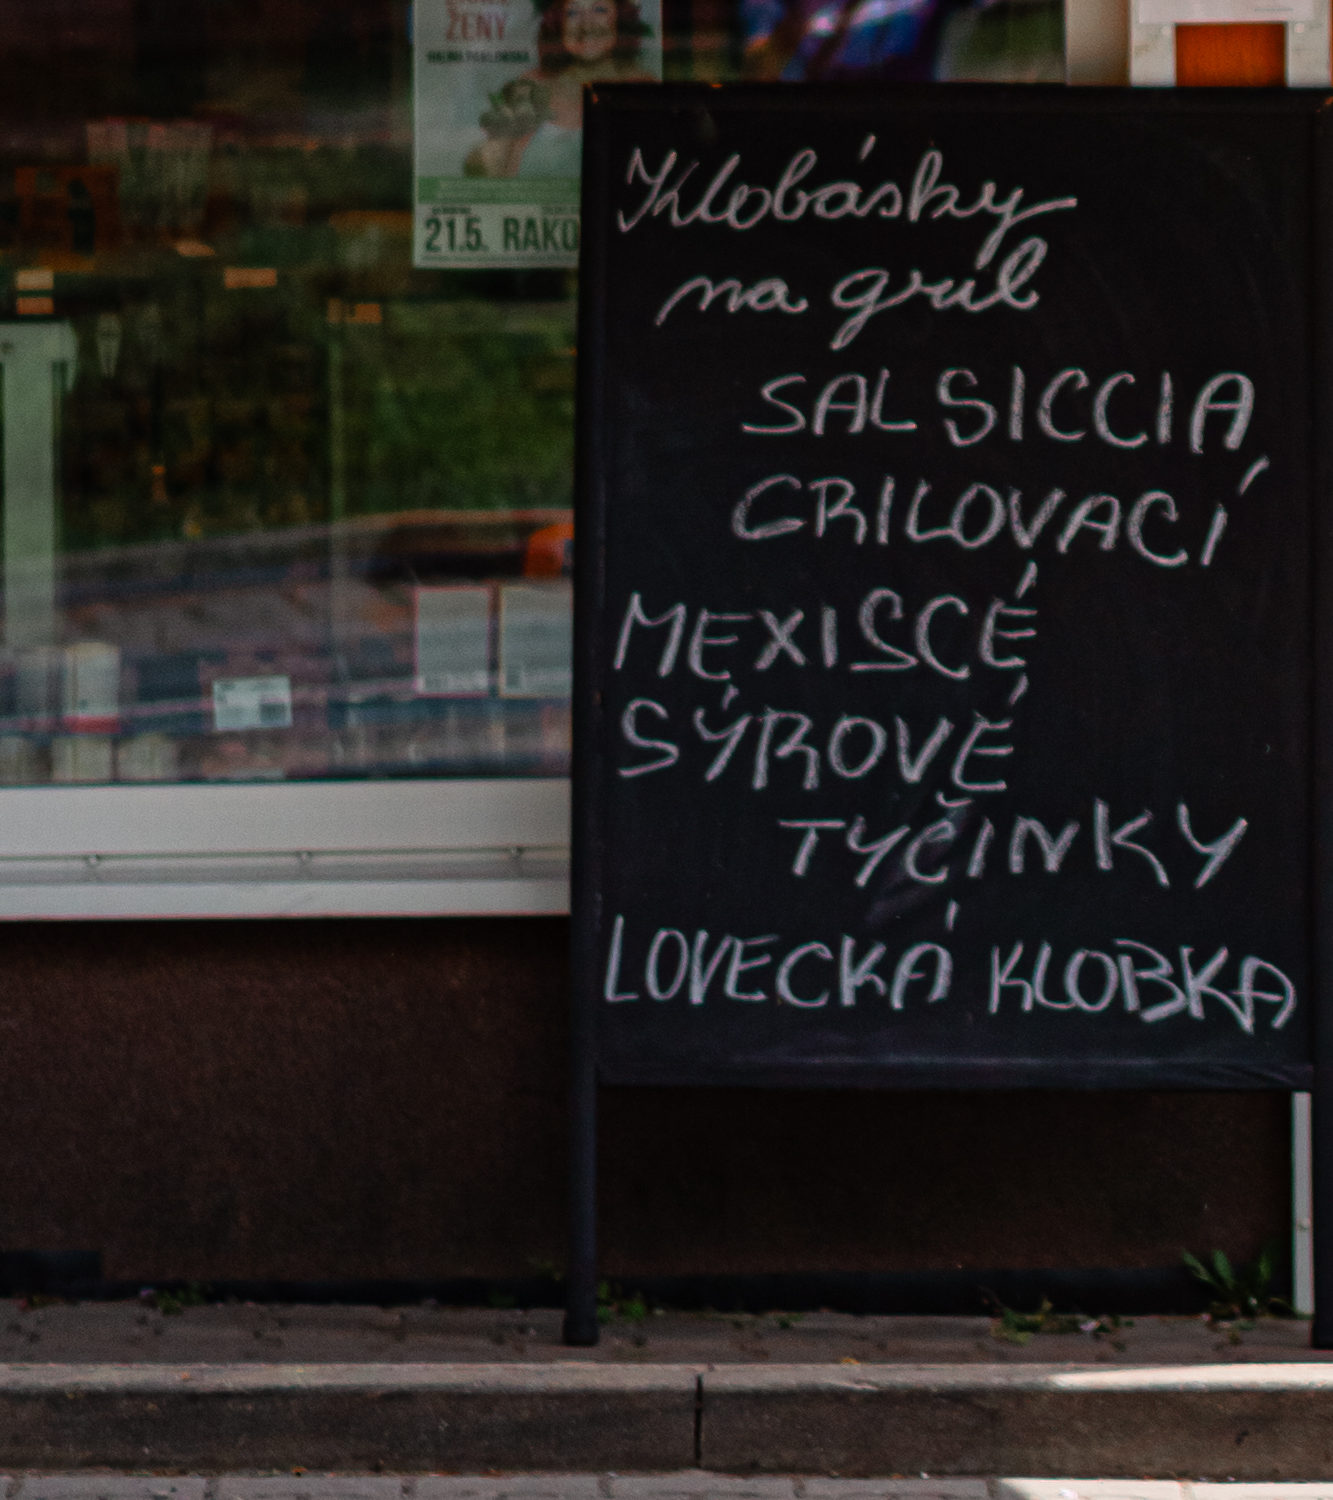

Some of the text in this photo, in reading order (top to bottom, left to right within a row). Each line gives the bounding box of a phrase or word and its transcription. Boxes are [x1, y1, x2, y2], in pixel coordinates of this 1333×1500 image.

[619, 135, 1077, 270] Klobásky
[655, 276, 808, 326] na
[618, 675, 1029, 790] SÝROVÉ
[779, 791, 1249, 888] TYČINKY
[605, 901, 954, 1010] LOVECKÁ
